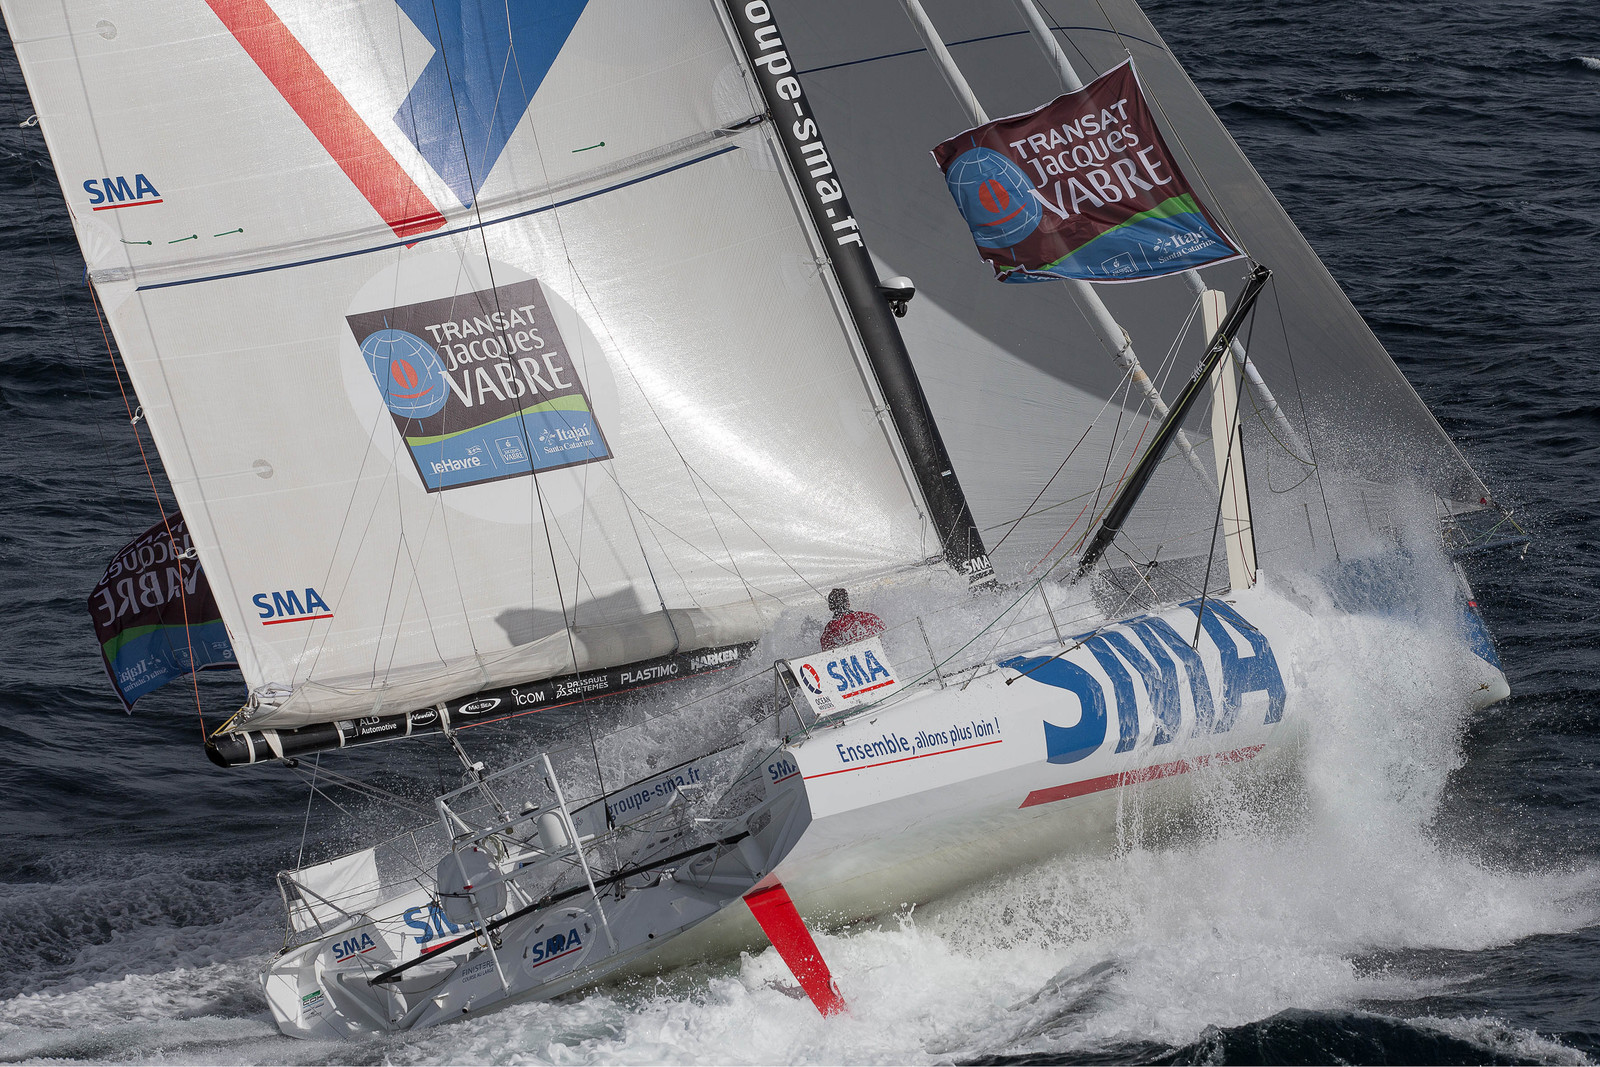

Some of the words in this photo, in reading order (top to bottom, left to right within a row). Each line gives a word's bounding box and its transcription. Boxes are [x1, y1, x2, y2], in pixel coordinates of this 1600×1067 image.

[1010, 98, 1128, 160] TRANSAT
[83, 174, 161, 204] SMA
[1027, 145, 1172, 220] VABRE
[1158, 250, 1182, 264] Santa
[425, 305, 536, 344] TRANSAT
[438, 351, 573, 408] VABRE
[555, 422, 590, 442] Itajaí
[544, 444, 564, 454] Santa
[563, 438, 594, 452] Catarina
[961, 554, 993, 575] SMA
[252, 588, 331, 618] SMA
[690, 648, 739, 670] HARKEN
[827, 650, 890, 692] SMA
[566, 675, 608, 689] DASSAULT
[620, 663, 679, 685] PLASTIMO
[996, 598, 1288, 765] SMA
[814, 696, 832, 706] OCEAN
[359, 715, 380, 727] ALD
[361, 722, 398, 735] Automotive
[915, 730, 949, 749] allons
[949, 725, 973, 746] plus
[973, 721, 995, 738] loin
[332, 932, 376, 959] SMA
[532, 928, 582, 963] SMA
